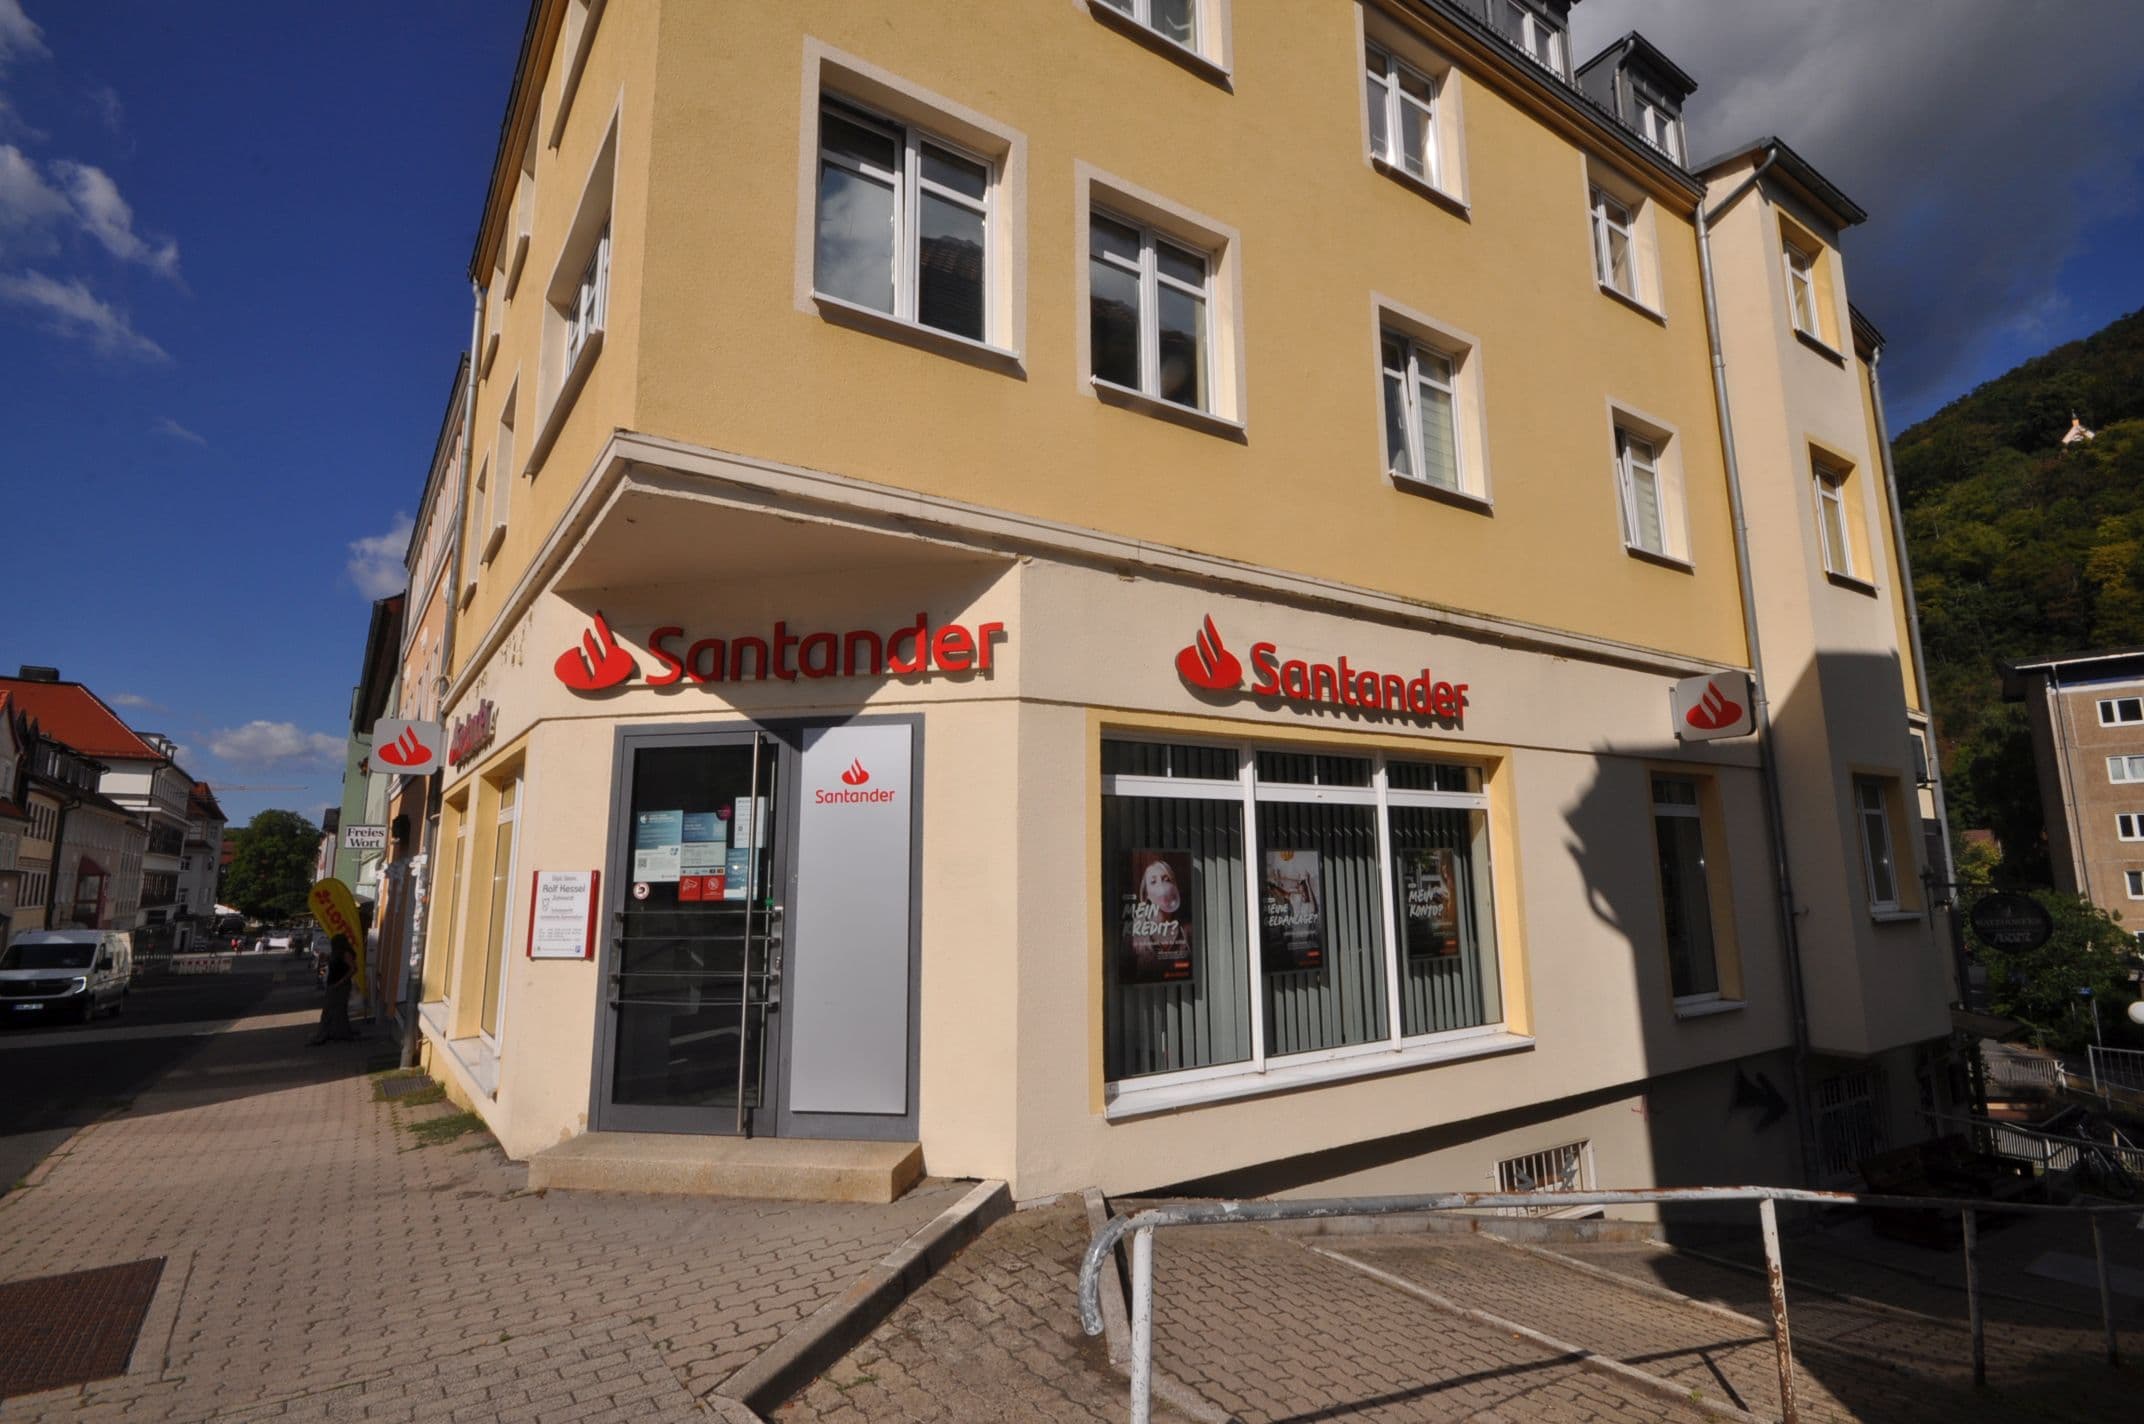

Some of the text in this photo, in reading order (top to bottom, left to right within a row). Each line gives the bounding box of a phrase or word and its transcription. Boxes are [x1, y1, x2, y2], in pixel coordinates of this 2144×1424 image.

[647, 612, 1005, 687] Santander
[1251, 642, 1469, 718] Santander
[815, 788, 895, 804] Santander
[348, 828, 385, 837] Freies
[350, 838, 380, 848] Wort
[542, 884, 558, 893] Rolf
[1408, 887, 1434, 903] MEIN
[1122, 902, 1160, 919] MEIN
[1409, 903, 1444, 918] KONTO?
[1122, 920, 1179, 937] KREDIT?
